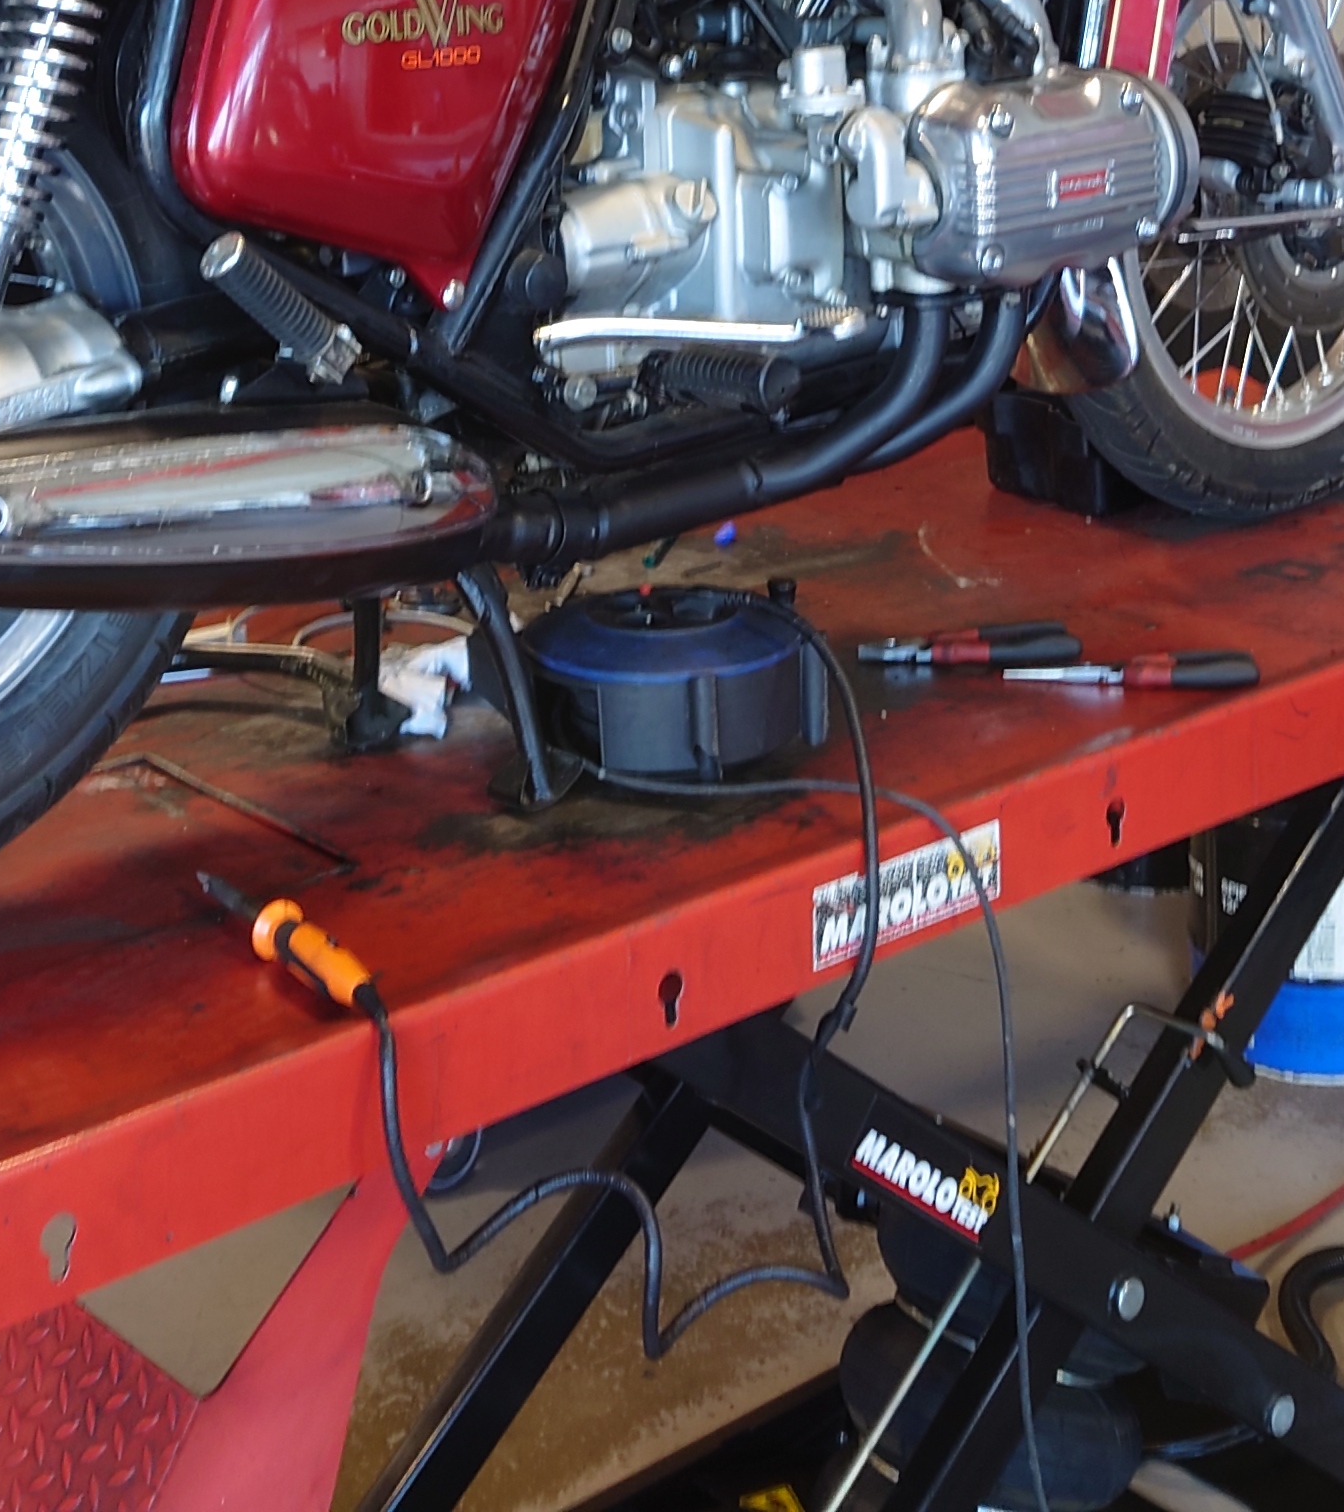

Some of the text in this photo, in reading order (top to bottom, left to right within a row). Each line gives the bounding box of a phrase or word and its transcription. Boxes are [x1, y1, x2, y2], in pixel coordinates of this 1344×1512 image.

[400, 44, 482, 71] GL1000
[854, 1127, 989, 1235] MAROLO TEST
